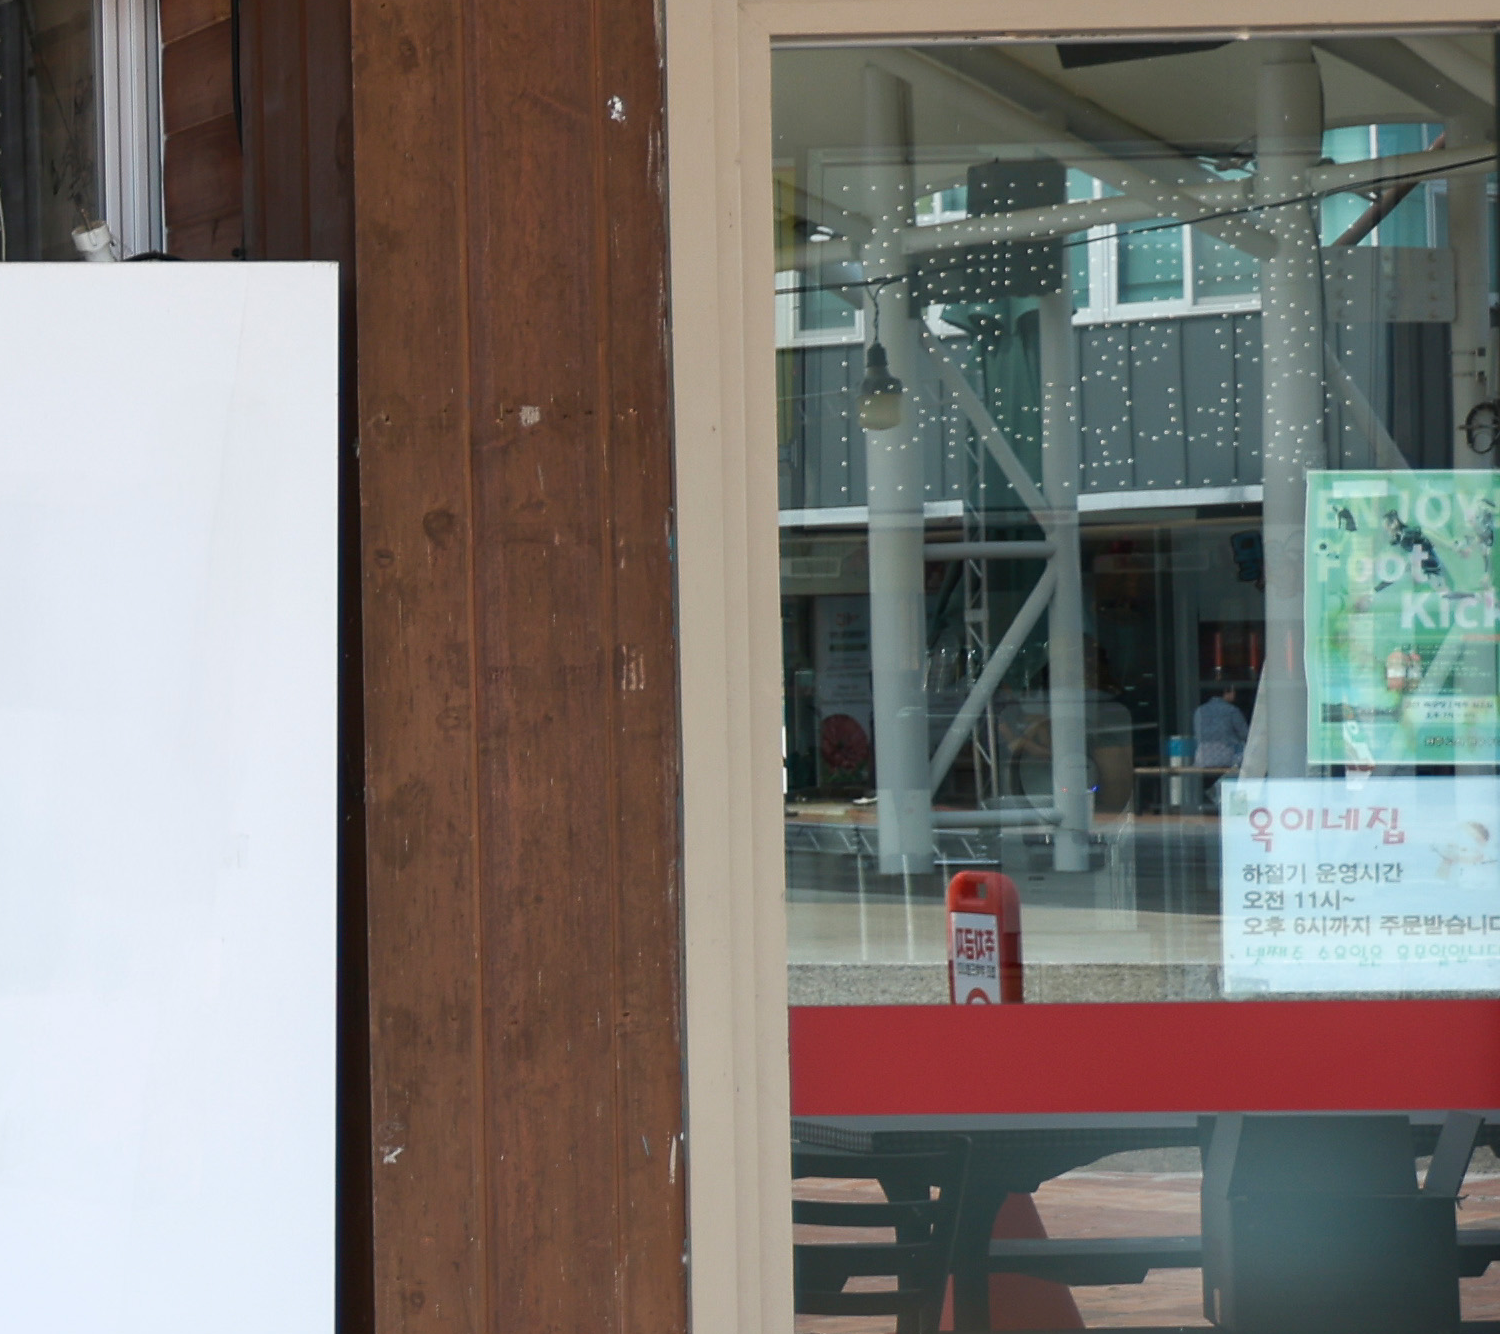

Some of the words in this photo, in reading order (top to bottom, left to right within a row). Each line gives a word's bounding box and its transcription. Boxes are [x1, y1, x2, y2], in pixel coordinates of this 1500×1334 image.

[1250, 806, 1405, 853] 옥이네집
[1242, 862, 1306, 885] 하절기
[1316, 861, 1404, 884] 운영시간
[1242, 890, 1285, 911] 오전
[1294, 889, 1355, 911] 11시~
[1242, 916, 1285, 937] 오후
[1293, 915, 1371, 937] 6시까지
